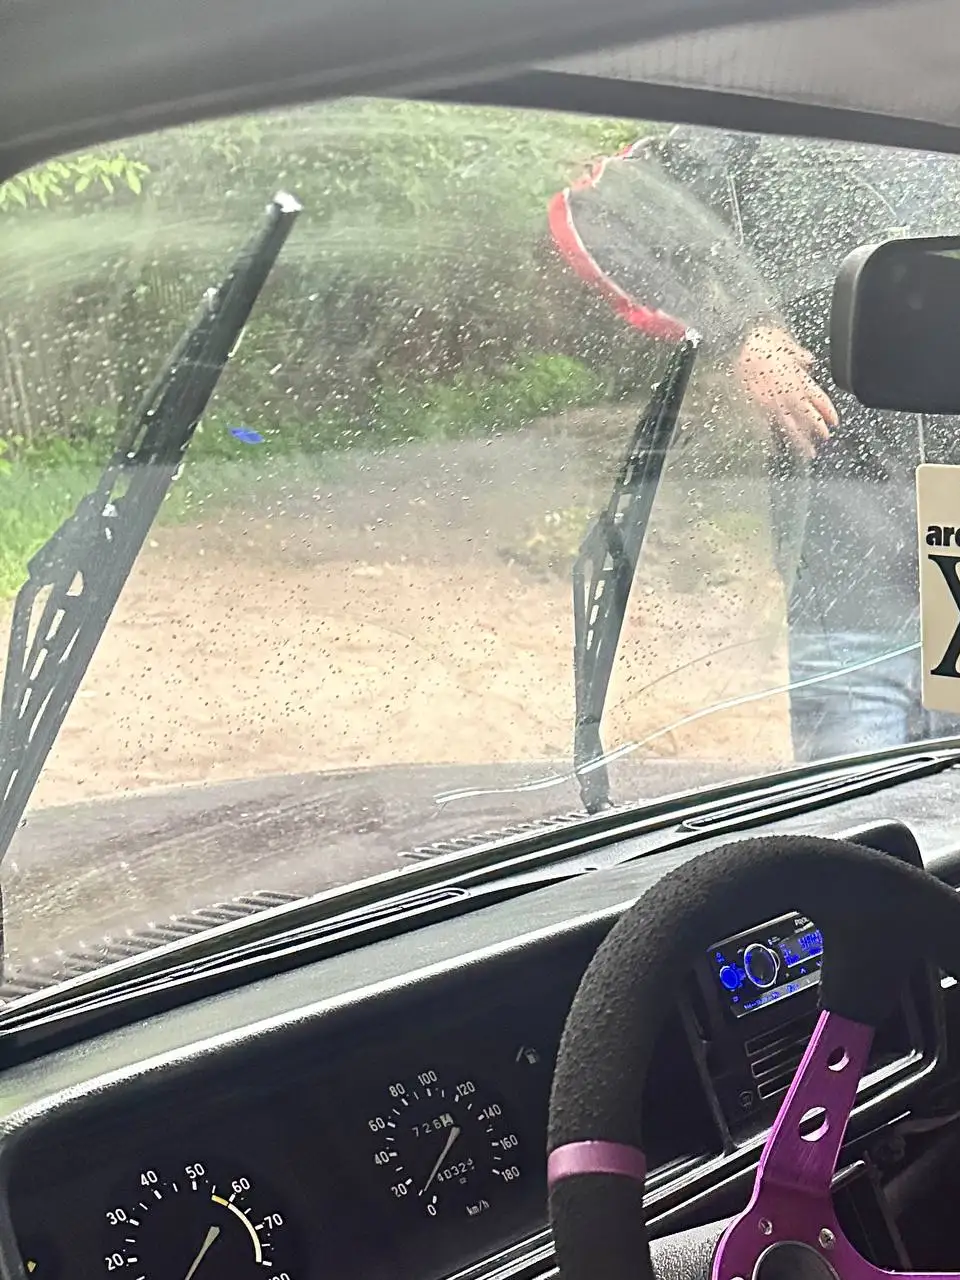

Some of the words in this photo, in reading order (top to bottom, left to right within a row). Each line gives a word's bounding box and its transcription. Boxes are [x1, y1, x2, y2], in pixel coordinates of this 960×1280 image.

[417, 1070, 438, 1087] 100
[388, 1082, 406, 1098] 80
[456, 1080, 476, 1097] 120
[483, 1103, 502, 1120] 140
[368, 1116, 386, 1132] 60
[500, 1134, 519, 1151] 160
[374, 1150, 390, 1166] 40
[140, 1169, 158, 1187] 40
[185, 1162, 205, 1180] 50
[501, 1165, 520, 1182] 180
[231, 1176, 251, 1194] 60
[391, 1183, 408, 1198] 20
[427, 1203, 437, 1216] 0
[466, 1199, 490, 1216] km/h
[106, 1207, 127, 1226] 30
[263, 1212, 284, 1230] 70
[104, 1252, 125, 1271] 20
